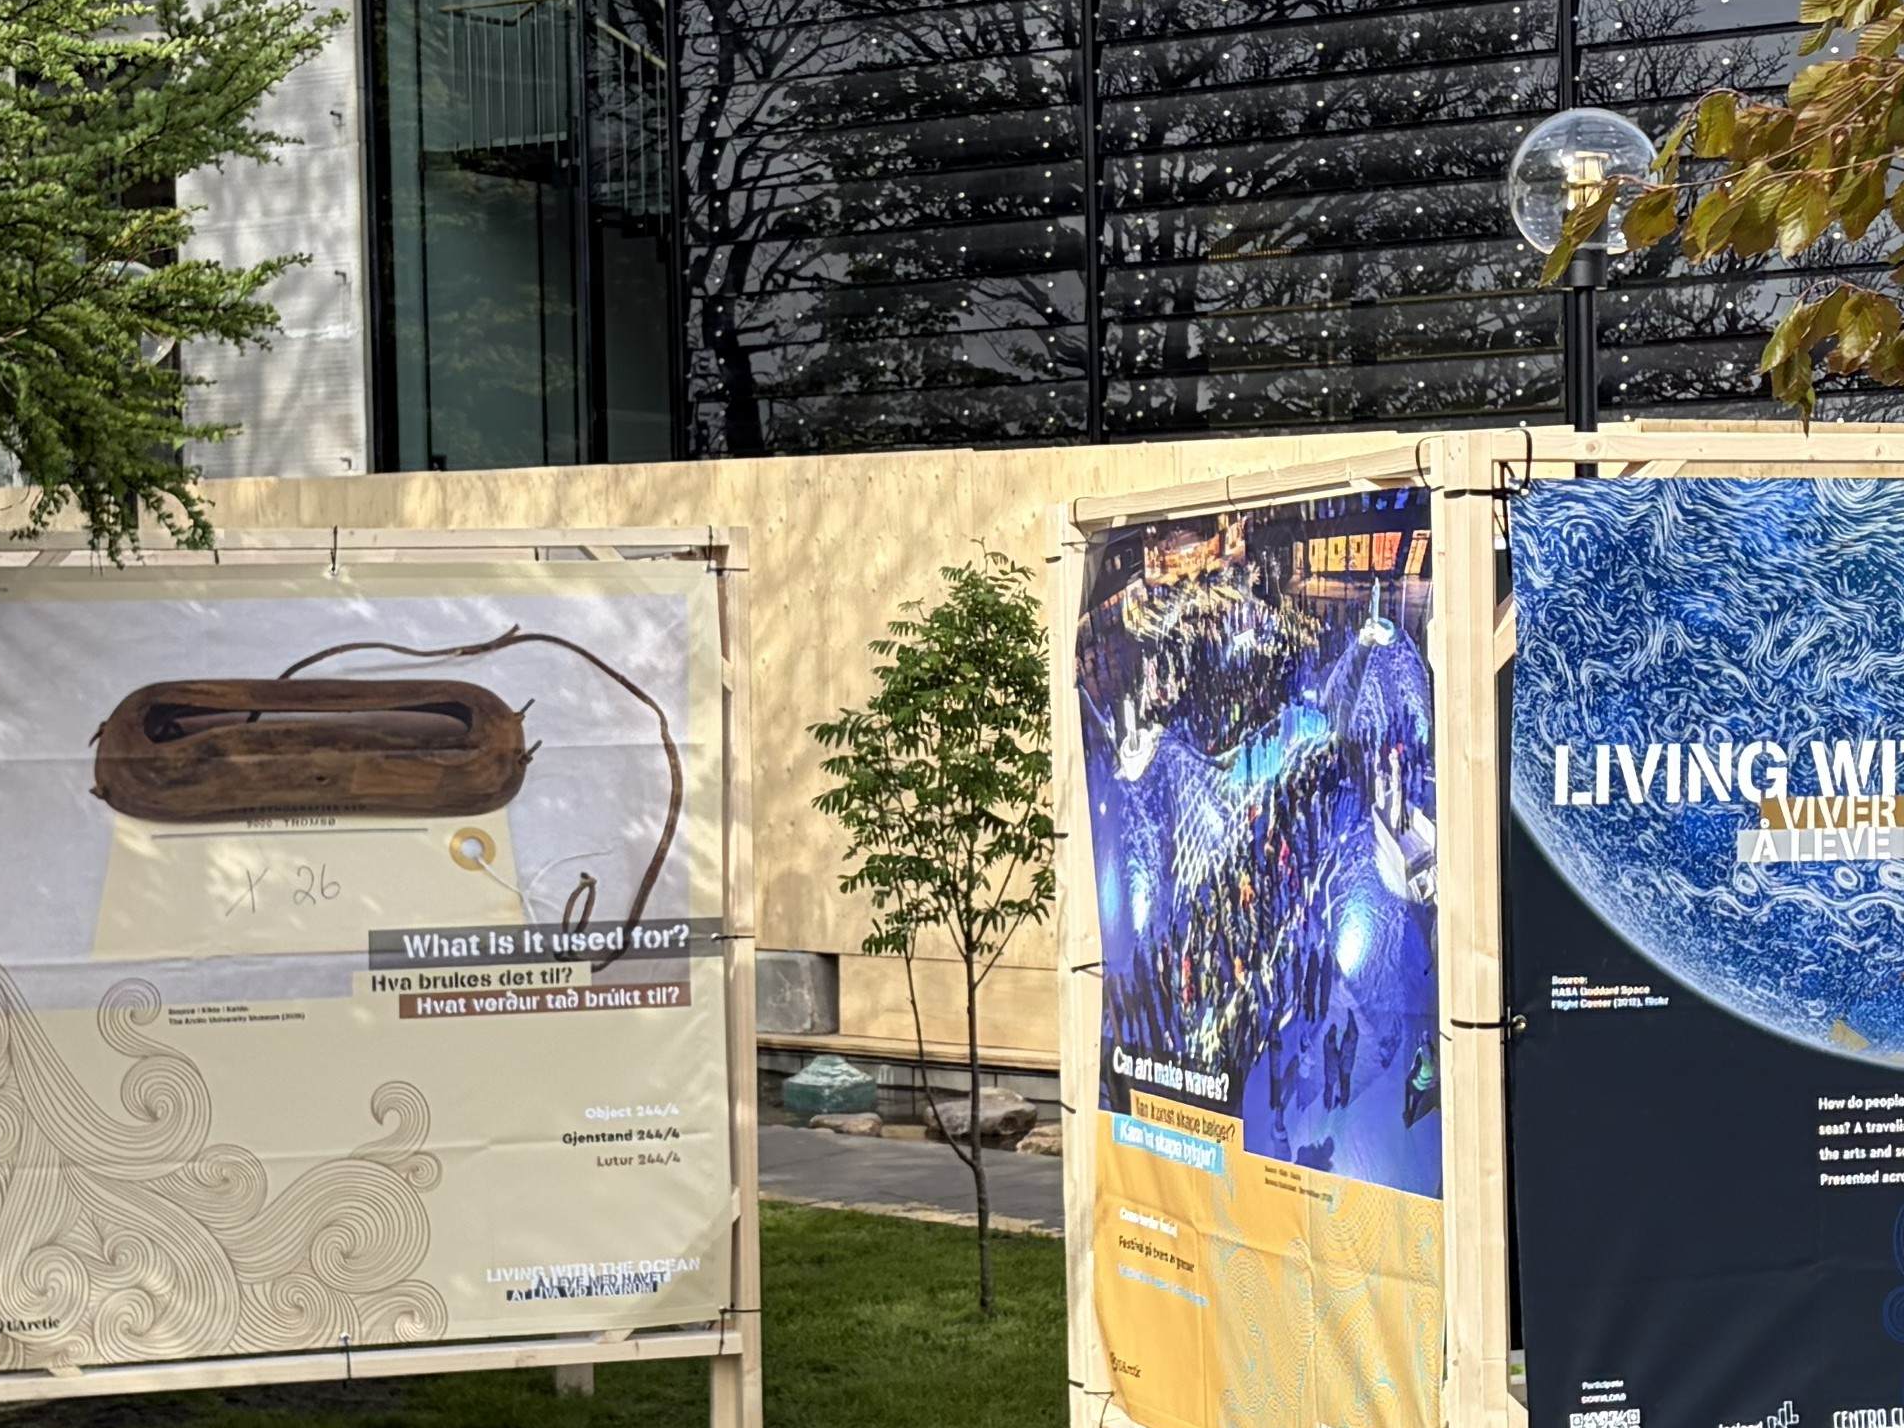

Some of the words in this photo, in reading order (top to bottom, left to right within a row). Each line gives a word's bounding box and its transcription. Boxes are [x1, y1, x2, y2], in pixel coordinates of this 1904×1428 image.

[1554, 740, 1788, 805] LIVING
[1776, 795, 1896, 830] VIVER
[1751, 818, 1780, 863] Å
[1791, 827, 1891, 862] LEVE
[292, 863, 342, 906] 26
[402, 933, 481, 959] What
[488, 930, 516, 956] is
[523, 928, 545, 954] it
[552, 925, 625, 953] used
[631, 923, 690, 949] for?
[370, 974, 412, 993] Hva
[418, 971, 492, 991] brukes
[498, 968, 533, 987] det
[540, 966, 574, 985] til?
[1551, 975, 1588, 986] Source:
[415, 996, 467, 1016] Hvat
[545, 988, 580, 1009] tað
[584, 986, 642, 1008] brúkt
[646, 985, 681, 1006] til?
[1551, 987, 1578, 997] NASA
[1620, 985, 1651, 997] Space
[1551, 999, 1579, 1011] Flight
[1580, 998, 1612, 1009] Center
[1113, 1046, 1134, 1077] Can
[1135, 1057, 1154, 1083] art
[1154, 1059, 1184, 1091] make
[1184, 1070, 1230, 1103] waves?
[584, 1105, 632, 1121] Object
[636, 1102, 680, 1118] 244/4
[1818, 1097, 1846, 1110] How
[1847, 1095, 1863, 1109] do
[561, 1129, 633, 1147] Gjenstand
[637, 1126, 681, 1142] 244/4
[1818, 1121, 1851, 1136] seas?
[1853, 1122, 1863, 1134] A
[596, 1155, 634, 1168] Lutur
[637, 1150, 681, 1166] 244/4
[1819, 1146, 1840, 1161] the
[1842, 1146, 1867, 1160] arts
[1869, 1144, 1892, 1159] and
[1820, 1169, 1880, 1186] Presented
[486, 1265, 545, 1283] LIVING
[548, 1263, 596, 1278] WITH
[600, 1260, 634, 1276] THE
[637, 1256, 701, 1274] OCEAN
[511, 1289, 528, 1301] AT
